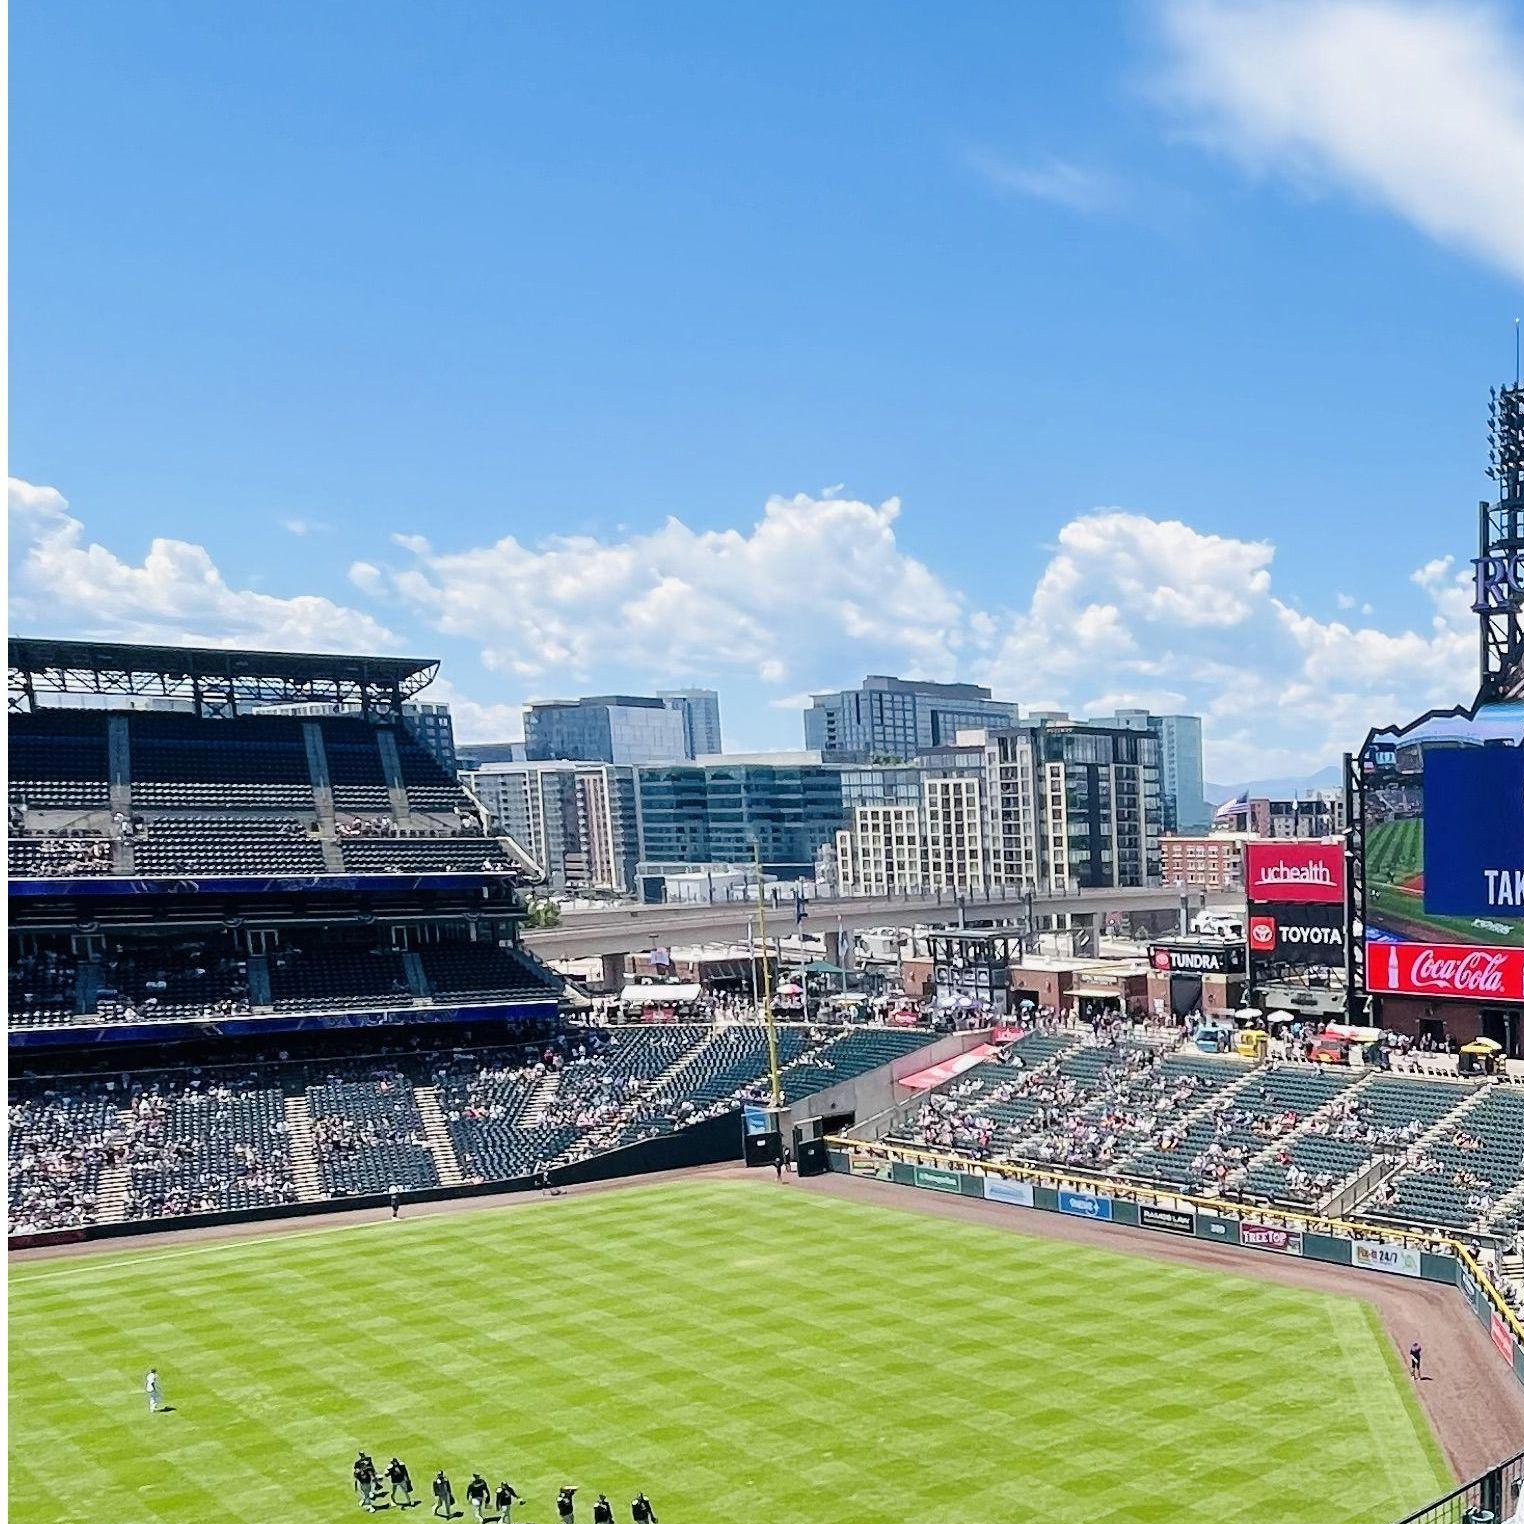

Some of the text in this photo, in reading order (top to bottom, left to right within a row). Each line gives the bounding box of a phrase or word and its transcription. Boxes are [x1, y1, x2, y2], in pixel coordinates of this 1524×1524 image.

[1261, 860, 1331, 882] uchealth
[1279, 926, 1343, 945] TOYOTA
[1170, 952, 1220, 970] TUNDRA
[1411, 949, 1508, 993] Coca-Cola
